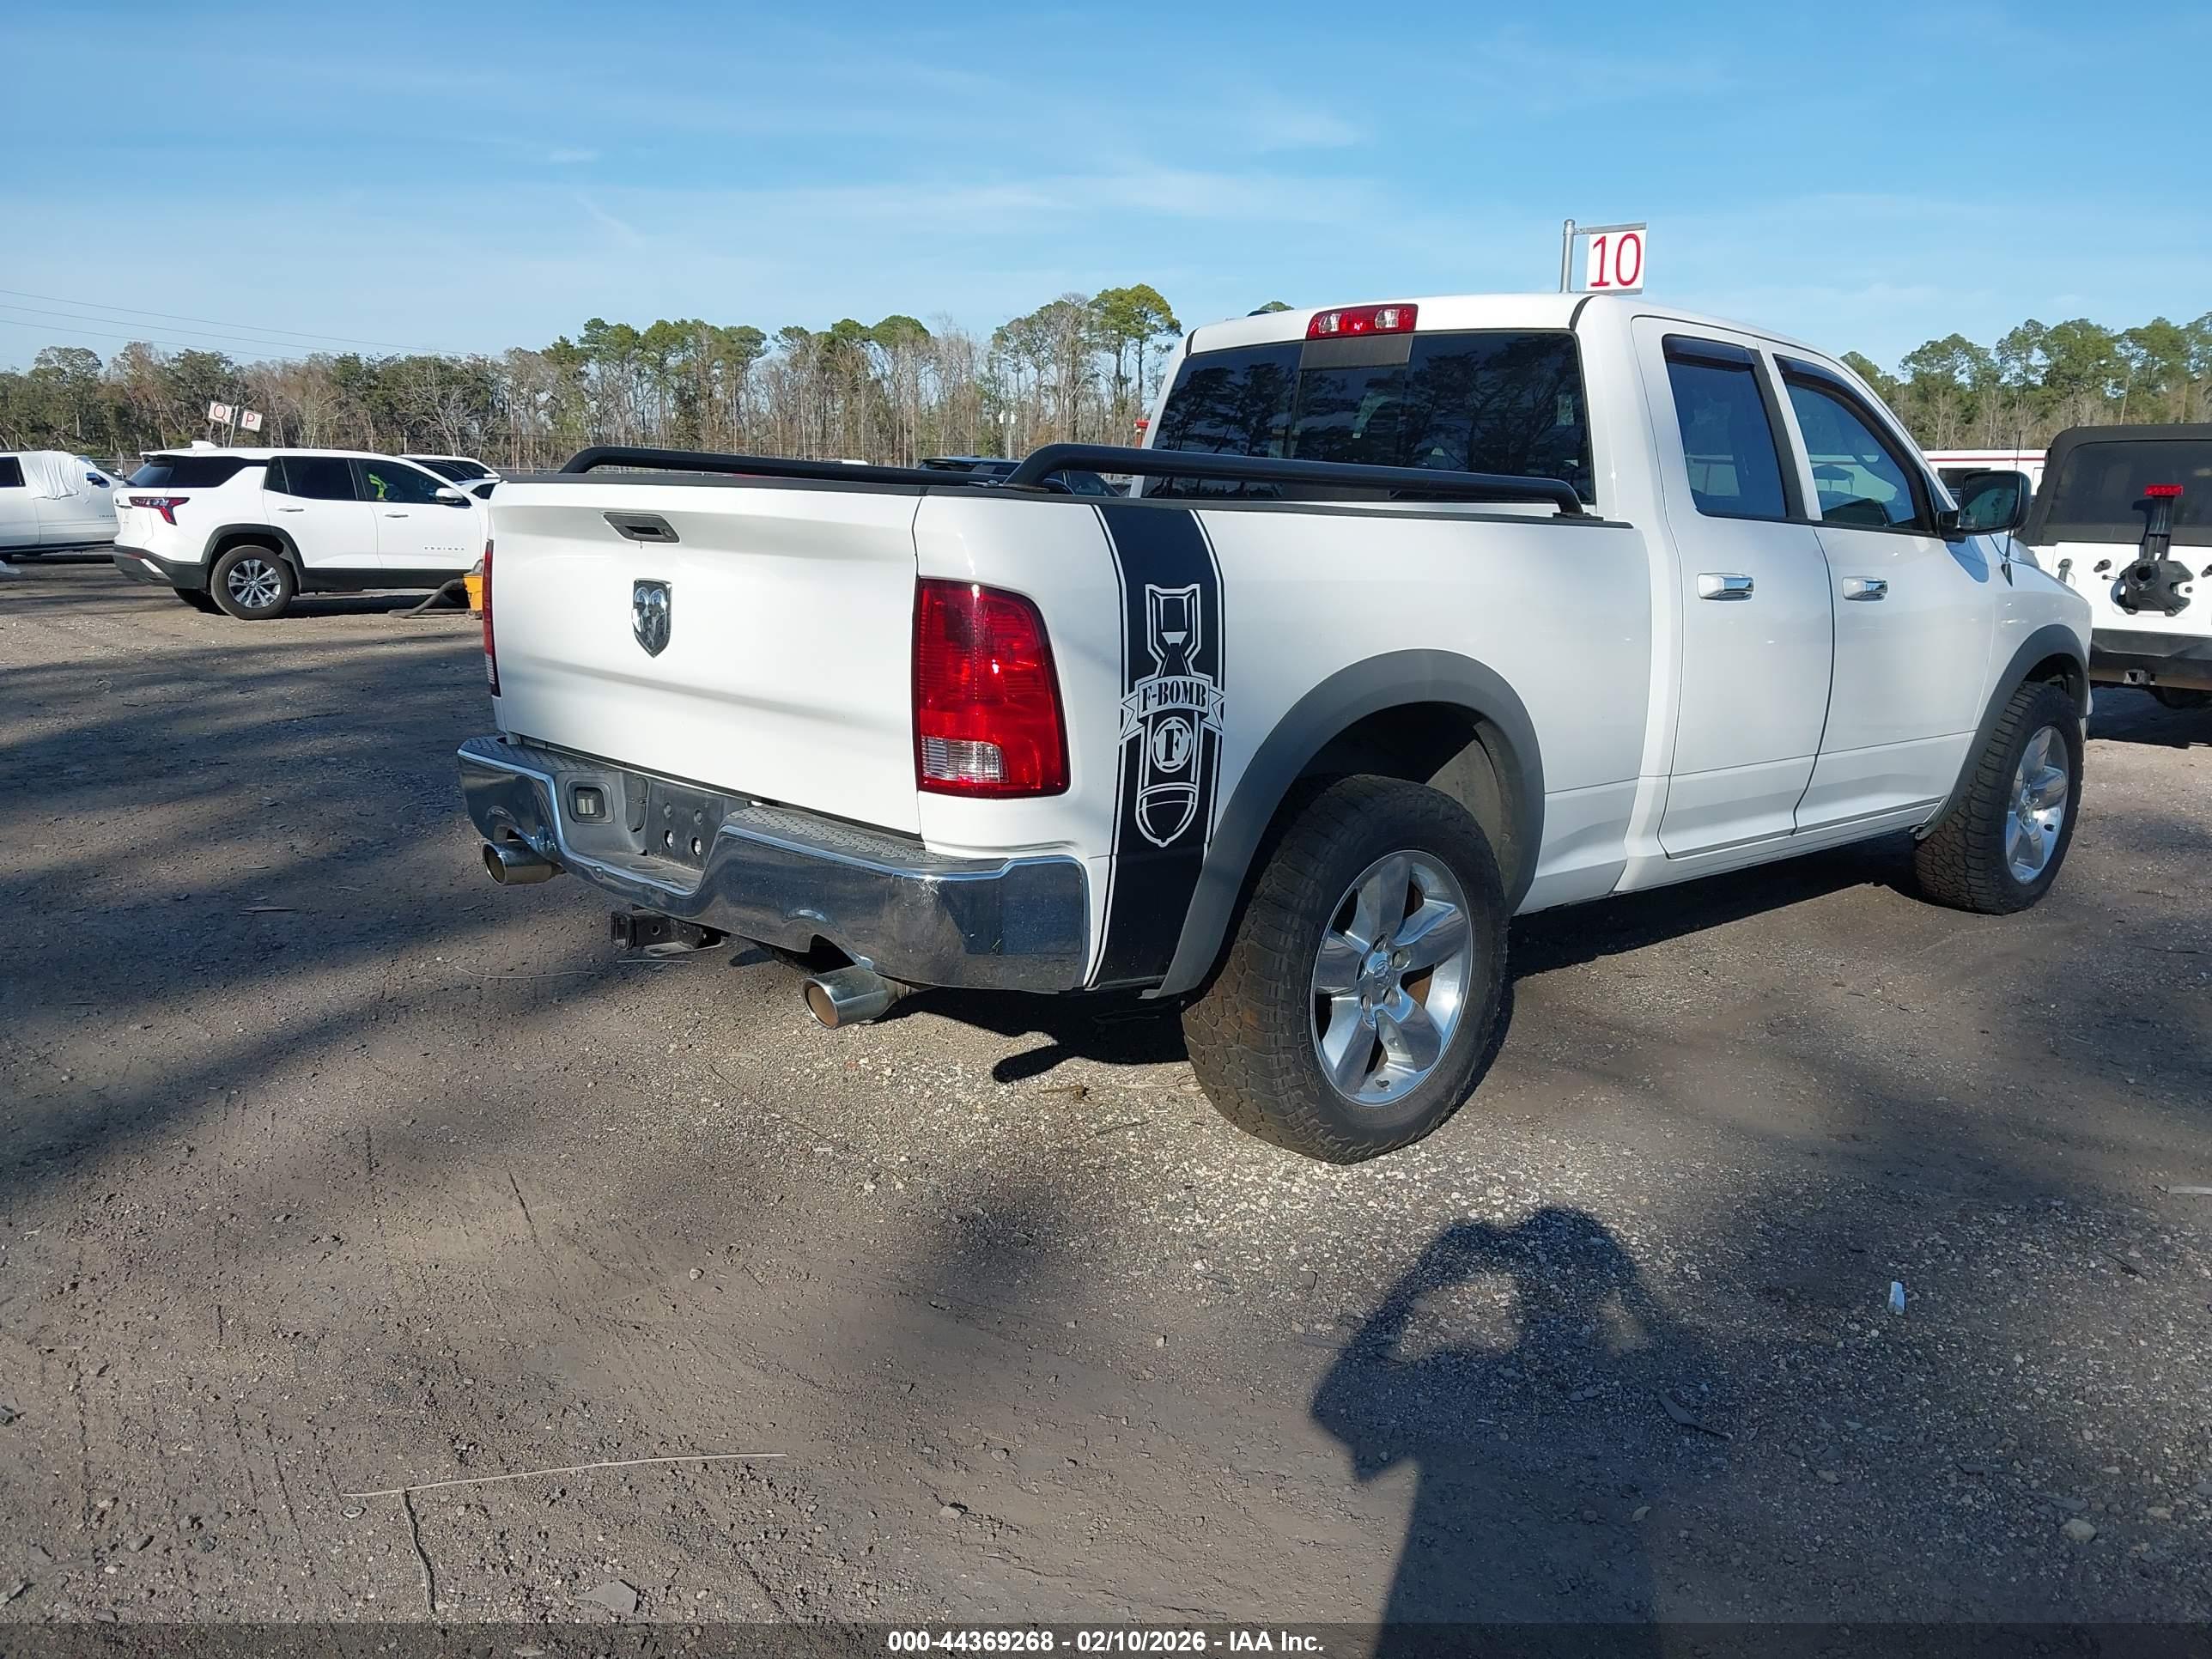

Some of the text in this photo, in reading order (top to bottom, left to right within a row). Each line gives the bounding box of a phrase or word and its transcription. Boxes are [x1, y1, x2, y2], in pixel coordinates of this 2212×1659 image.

[1590, 234, 1641, 287] 10
[214, 404, 226, 422] Q
[246, 413, 255, 426] P
[1142, 680, 1206, 712] F-BOMB
[1163, 727, 1182, 762] F
